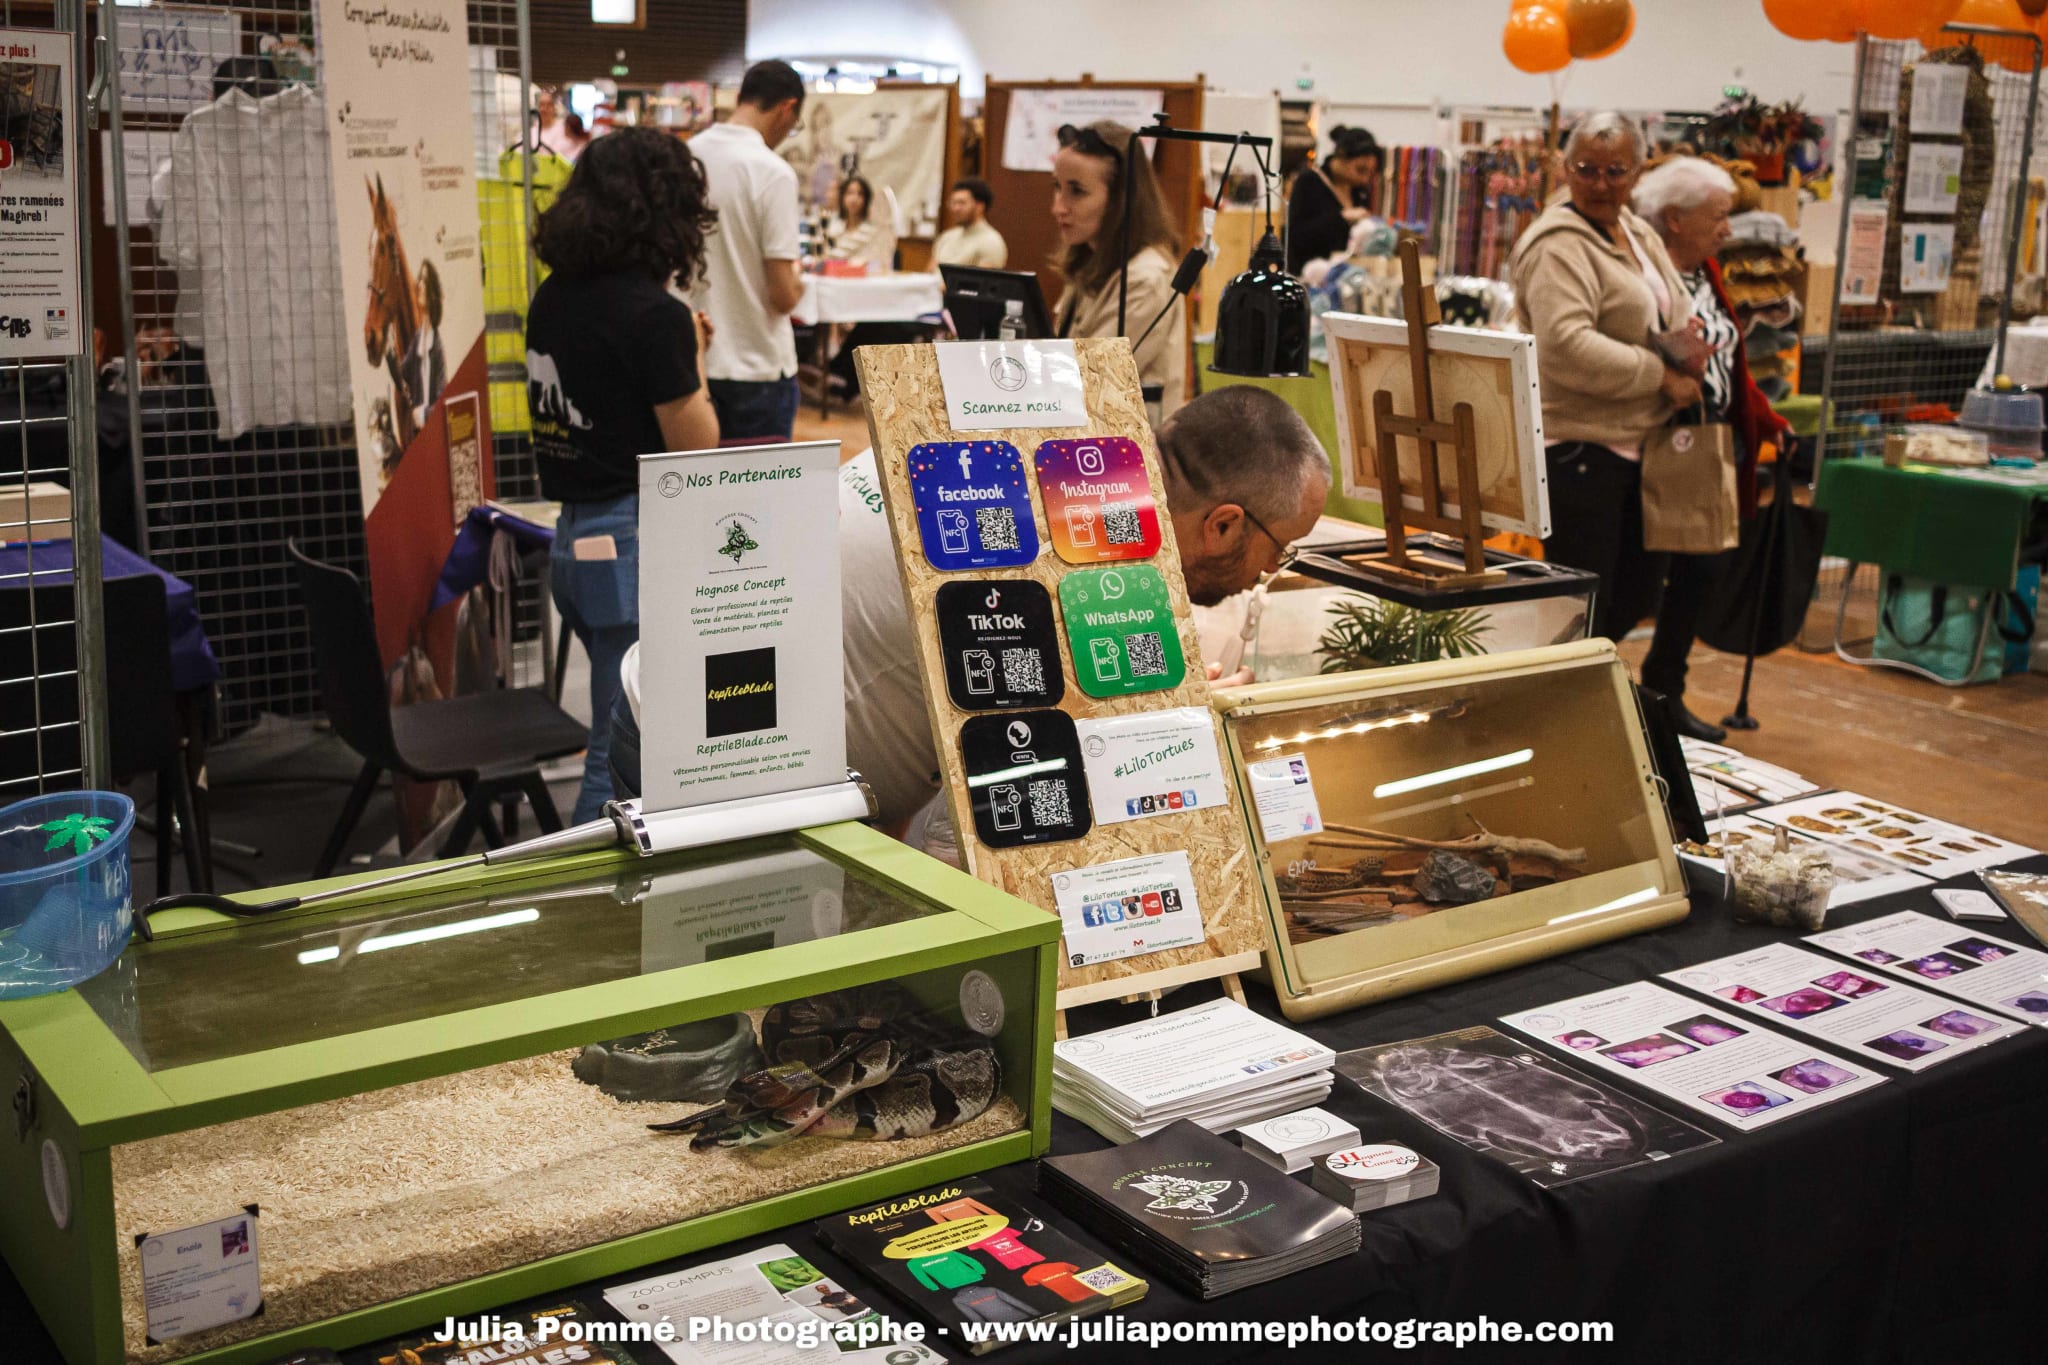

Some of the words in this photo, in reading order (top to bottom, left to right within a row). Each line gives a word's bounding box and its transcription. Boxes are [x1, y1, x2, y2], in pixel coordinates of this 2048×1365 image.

[9, 43, 30, 59] plus
[19, 193, 65, 207] ramenées
[1, 209, 42, 224] Maghreb
[962, 401, 1022, 415] Scannez
[1026, 400, 1063, 412] nous!
[686, 473, 713, 489] Nos
[719, 464, 803, 485] Partenaires
[937, 483, 1006, 502] facebook
[1060, 479, 1133, 502] Instagram
[945, 528, 961, 537] NFC
[1073, 523, 1088, 532] NFC
[695, 582, 740, 599] Hognose
[743, 576, 787, 593] Concept
[716, 601, 758, 614] professionnel
[760, 598, 768, 606] de
[769, 595, 794, 606] reptiles
[692, 616, 712, 626] Vente
[713, 613, 722, 623] de
[757, 607, 780, 619] plantes
[782, 606, 789, 615] et
[967, 613, 1027, 630] TikTok
[1084, 608, 1155, 626] WhatsApp
[699, 625, 741, 637] alimentation
[742, 624, 758, 634] pour
[759, 618, 784, 630] reptiles
[1097, 656, 1113, 666] NFC
[971, 669, 987, 678] NFC
[696, 732, 789, 756] ReptileBlade.com
[673, 764, 709, 776] Vêtements
[710, 756, 760, 771] personnalisable
[761, 753, 778, 762] selon
[779, 752, 790, 760] vos
[791, 748, 811, 758] envies
[1113, 737, 1196, 779] #LiloTortues
[679, 778, 697, 788] pour
[698, 773, 728, 784] hommes,
[729, 768, 758, 780] femmes,
[759, 763, 786, 775] enfants,
[787, 760, 805, 770] bébés
[997, 804, 1014, 814] NFC
[1082, 889, 1128, 903] @LiloTortues
[1132, 882, 1174, 894] #LiloTortues
[1339, 1150, 1394, 1165] Hognose
[1362, 1155, 1405, 1168] Concept
[1112, 1168, 1149, 1191] HOGNOSE
[1151, 1161, 1213, 1173] CONCEPT
[847, 1187, 963, 1227] ReptileBlade
[628, 1284, 665, 1299] ZOO
[666, 1266, 734, 1289] CAMPUS
